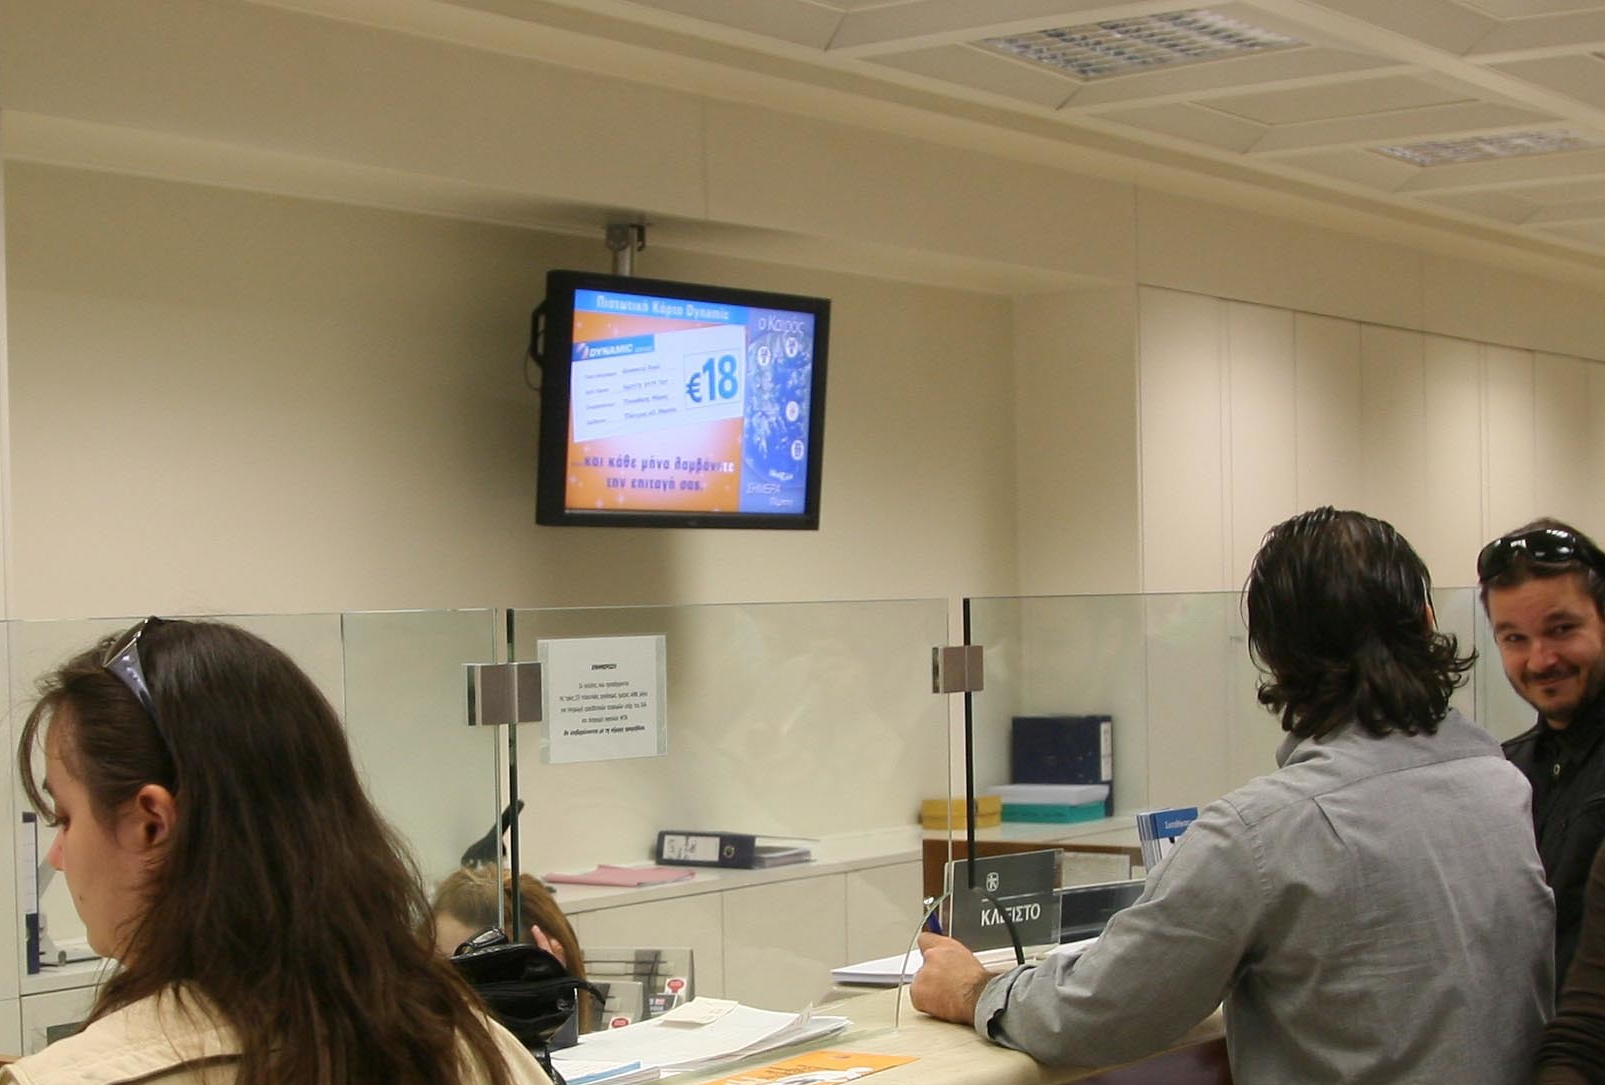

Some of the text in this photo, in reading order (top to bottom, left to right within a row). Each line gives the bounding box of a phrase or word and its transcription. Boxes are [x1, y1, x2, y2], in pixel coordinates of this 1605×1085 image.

[686, 304, 729, 320] Dynamic
[589, 344, 633, 358] DYNAMIC
[685, 354, 738, 403] €18
[608, 454, 636, 468] κάθε
[641, 455, 670, 472] μήνα
[606, 478, 625, 488] την
[631, 477, 675, 491] επιταγή
